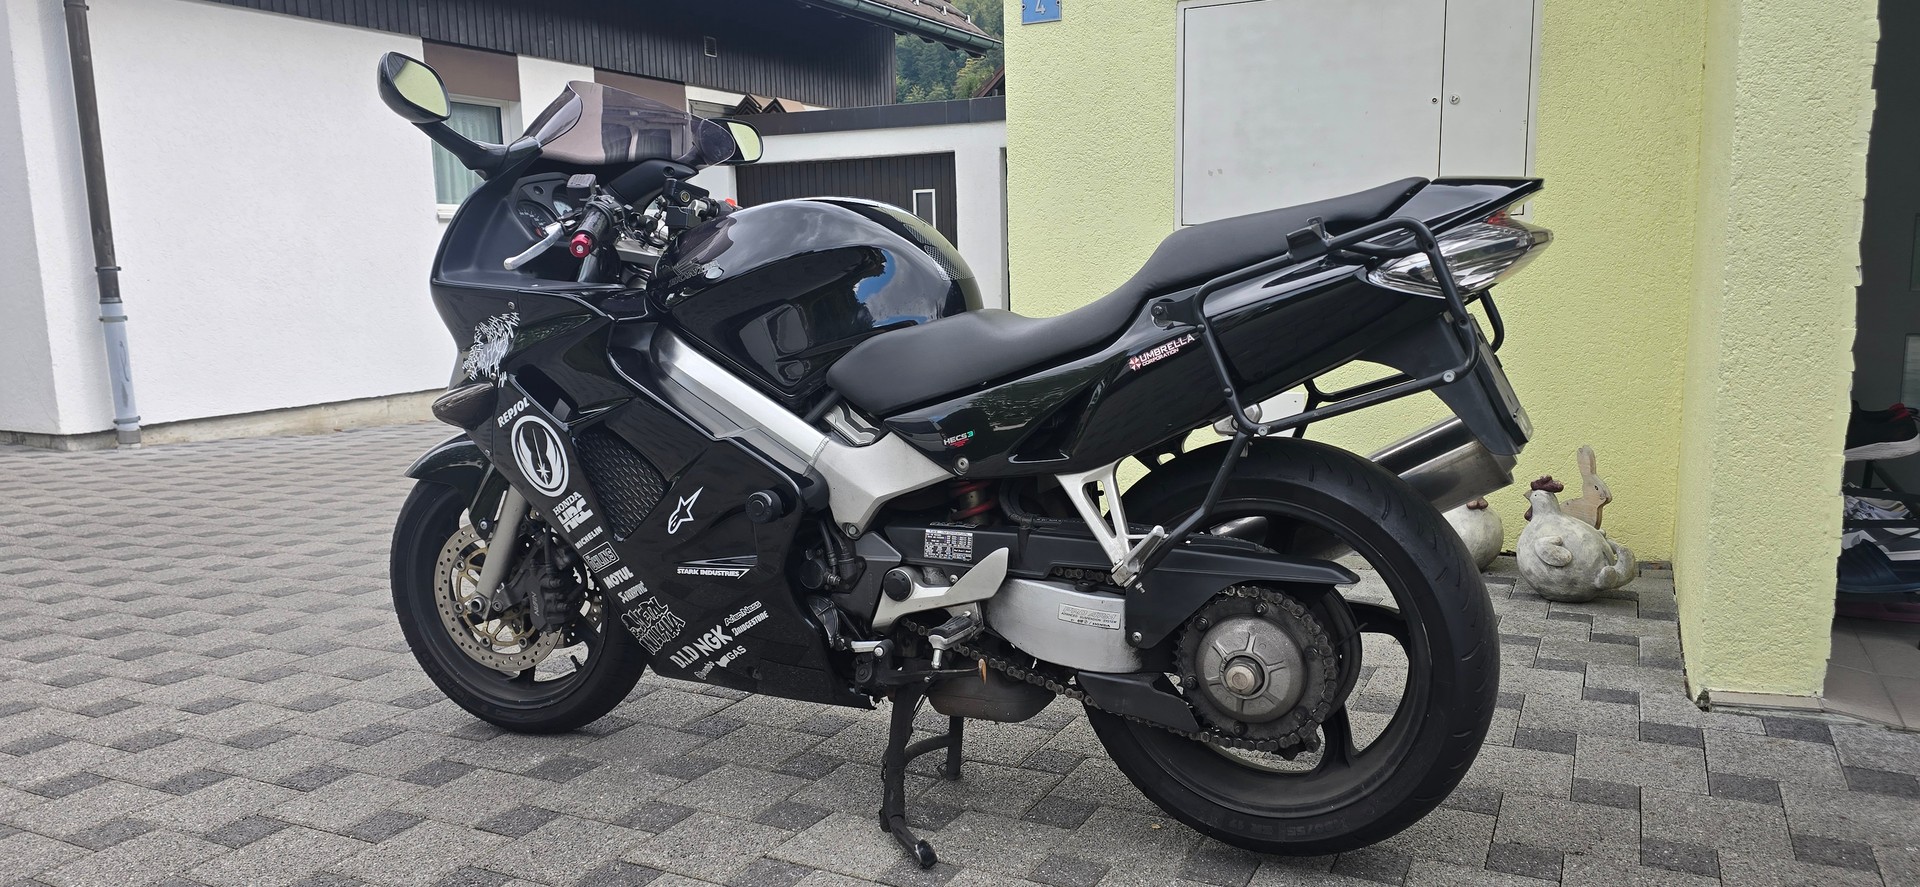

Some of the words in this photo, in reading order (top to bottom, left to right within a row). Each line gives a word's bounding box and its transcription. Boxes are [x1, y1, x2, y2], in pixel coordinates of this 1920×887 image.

[1035, 0, 1046, 14] 4
[1140, 333, 1195, 361] UMBRELLA
[1142, 347, 1179, 366] CORPORATION
[497, 397, 530, 428] REPSOL
[553, 491, 582, 516] HONDA
[575, 526, 603, 549] MICHELIN
[603, 566, 634, 589] MOTUL
[700, 569, 740, 577] INDUSTRIES
[731, 610, 769, 637] BRIDGESTONE
[692, 624, 733, 657] NGK
[670, 645, 700, 669] D.I.D
[726, 645, 747, 660] GAS
